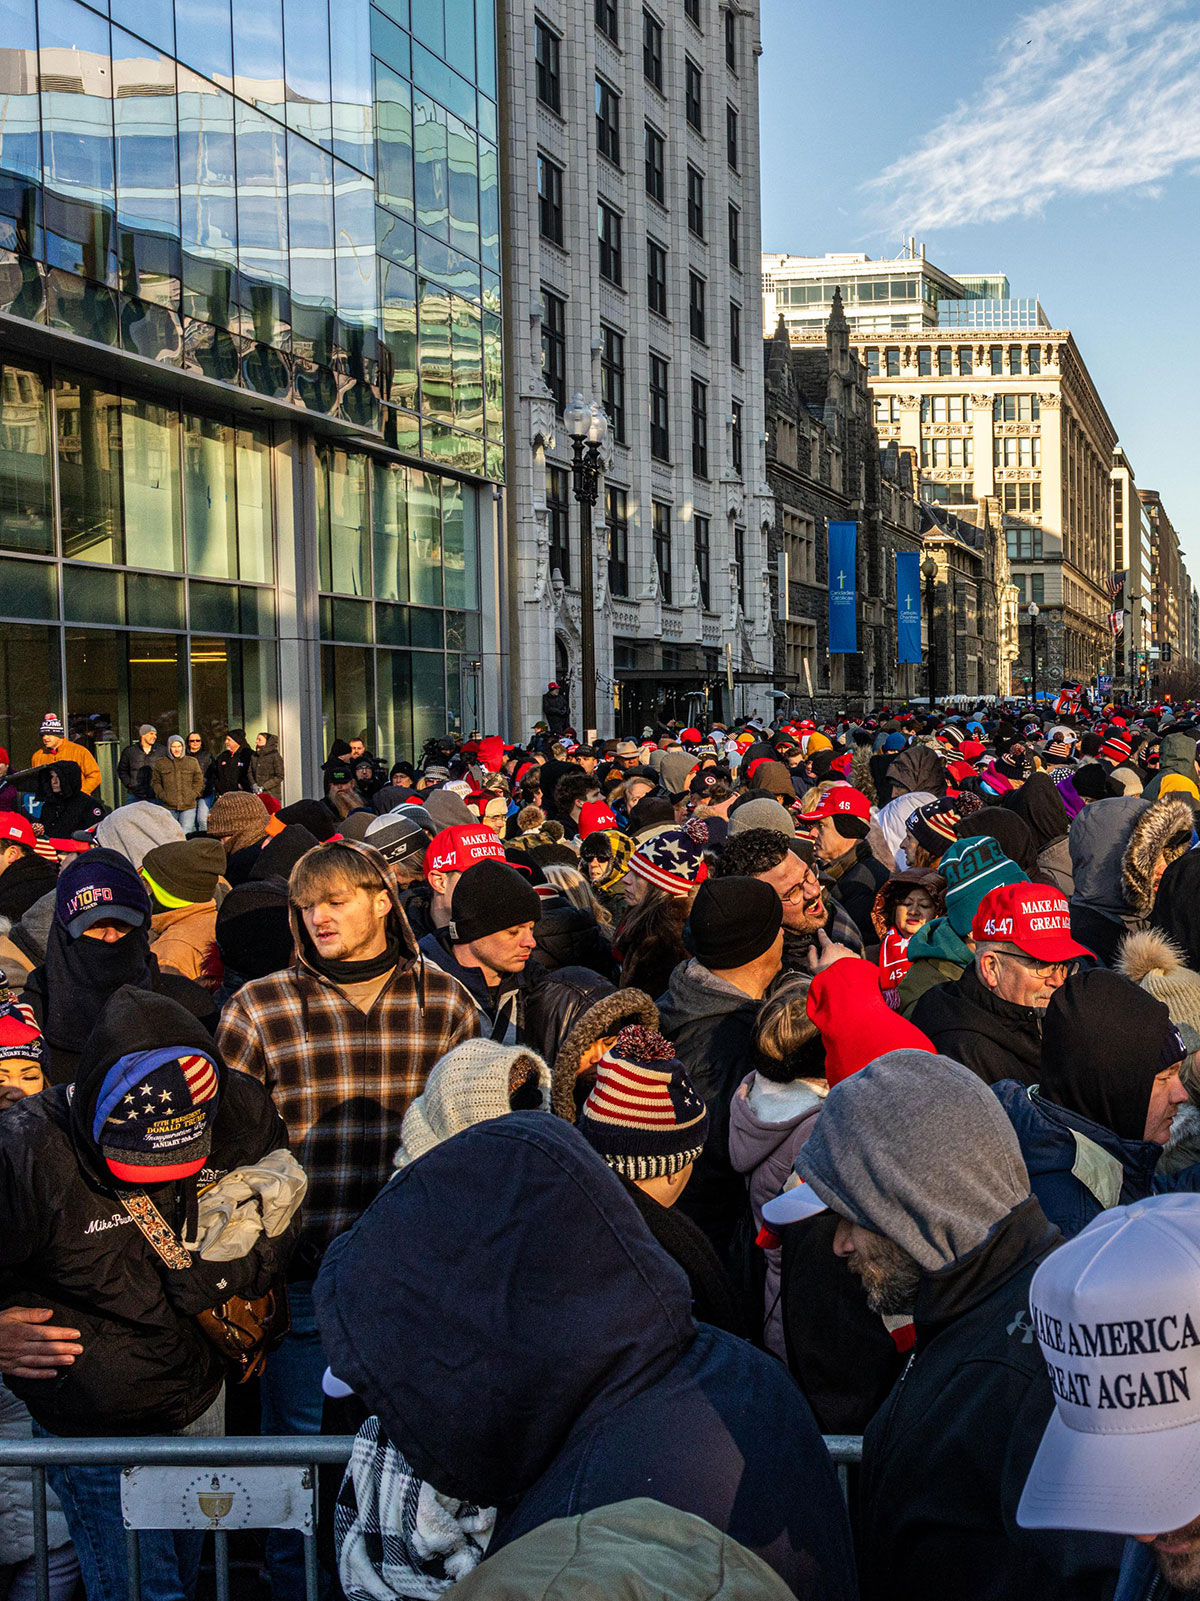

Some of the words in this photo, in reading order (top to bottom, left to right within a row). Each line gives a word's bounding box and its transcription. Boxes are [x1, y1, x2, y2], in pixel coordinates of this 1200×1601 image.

[838, 800, 850, 809] 45
[597, 816, 606, 824] 45
[461, 834, 489, 846] MAKE
[471, 846, 497, 858] GREAT
[432, 851, 456, 869] 45-47
[945, 840, 1004, 887] AGLE
[1021, 900, 1053, 914] MAKE
[984, 918, 1013, 935] 45-47
[1030, 916, 1062, 931] GREAT
[147, 1123, 182, 1134] DONALD
[184, 1112, 206, 1127] TRUMP
[171, 1109, 202, 1125] PRESIDENT
[143, 1128, 192, 1143] Inauguration
[193, 1121, 208, 1131] Day
[152, 1138, 180, 1149] JANUARY
[84, 1219, 113, 1234] Mike
[1098, 1366, 1191, 1409] AGAIN
